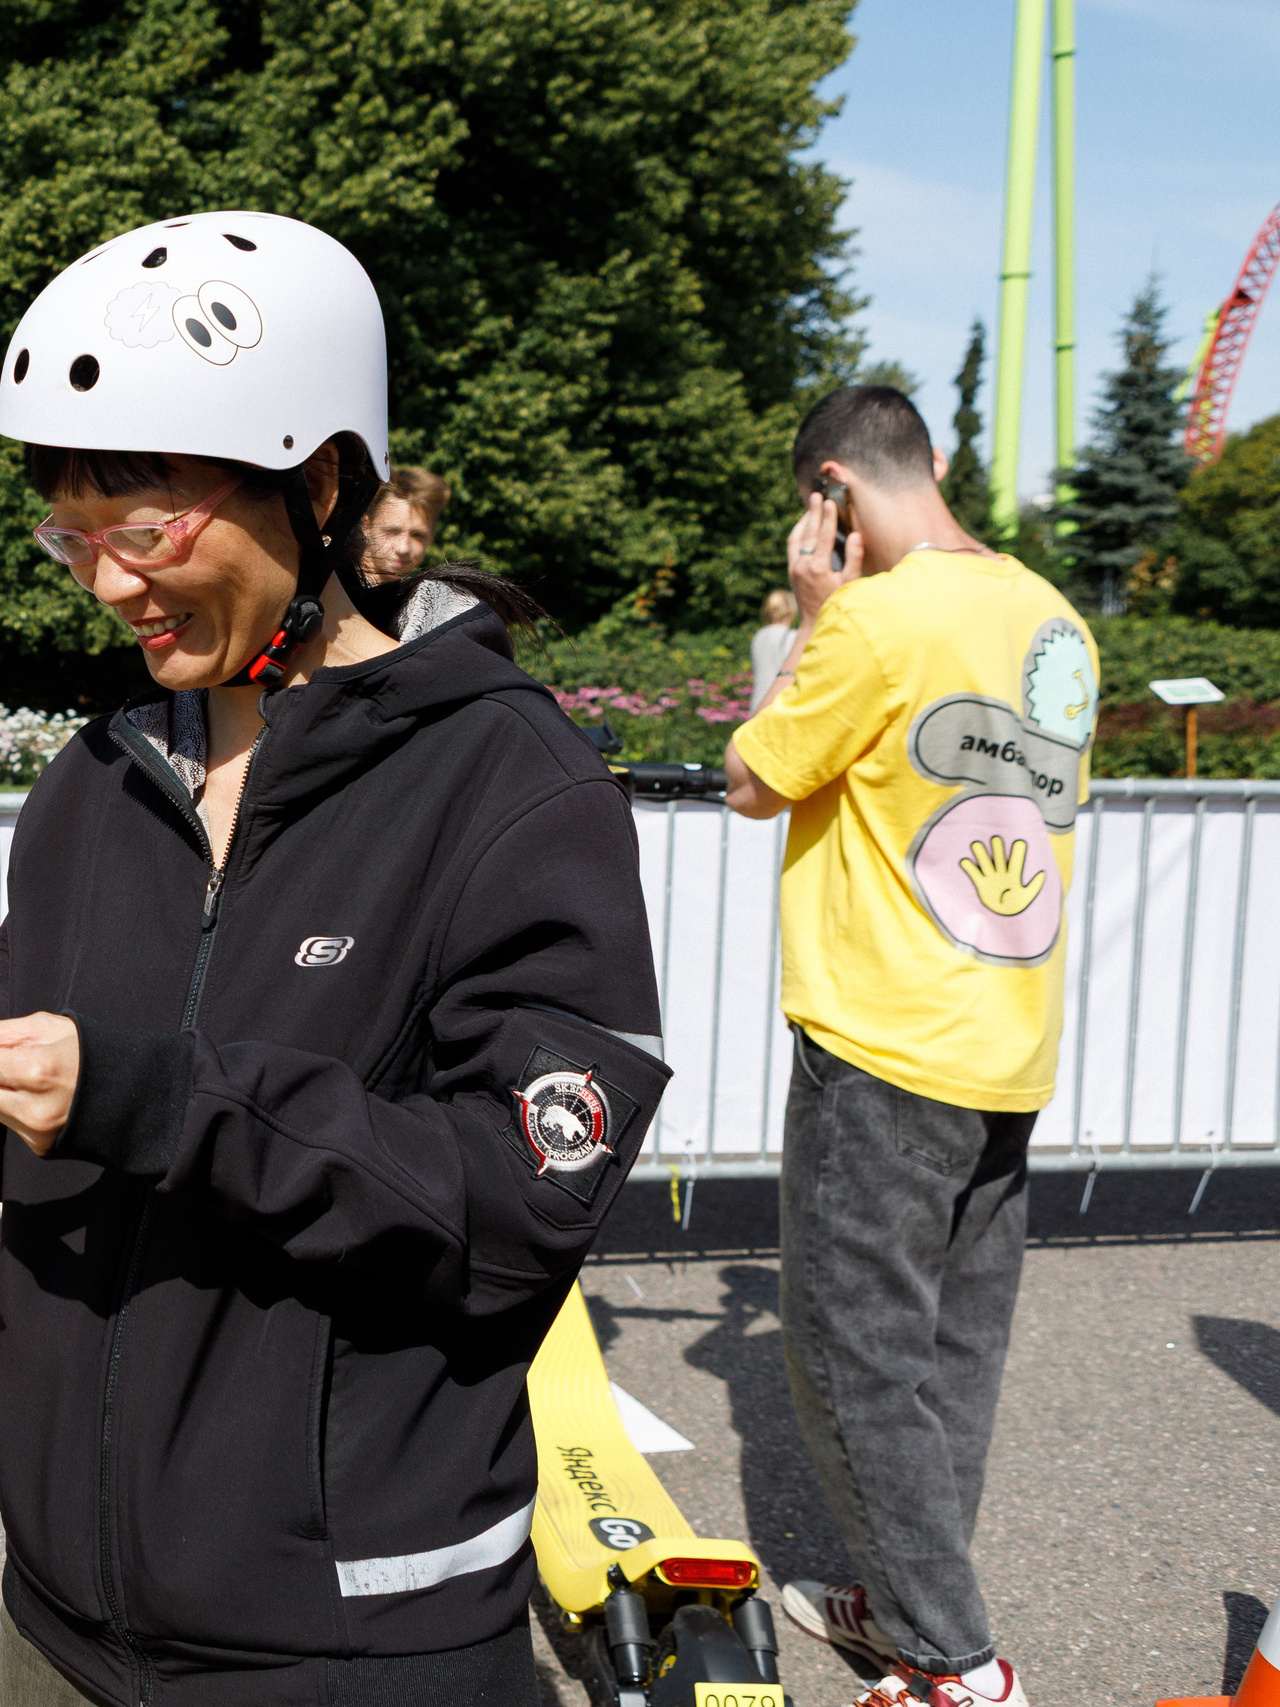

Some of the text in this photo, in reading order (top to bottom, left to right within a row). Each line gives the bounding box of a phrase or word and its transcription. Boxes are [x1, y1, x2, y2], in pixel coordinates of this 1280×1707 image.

[555, 1083, 600, 1113] SKECHERS
[548, 1140, 594, 1160] PROGRAM
[557, 1446, 617, 1512] Яндекс
[599, 1519, 641, 1549] Go
